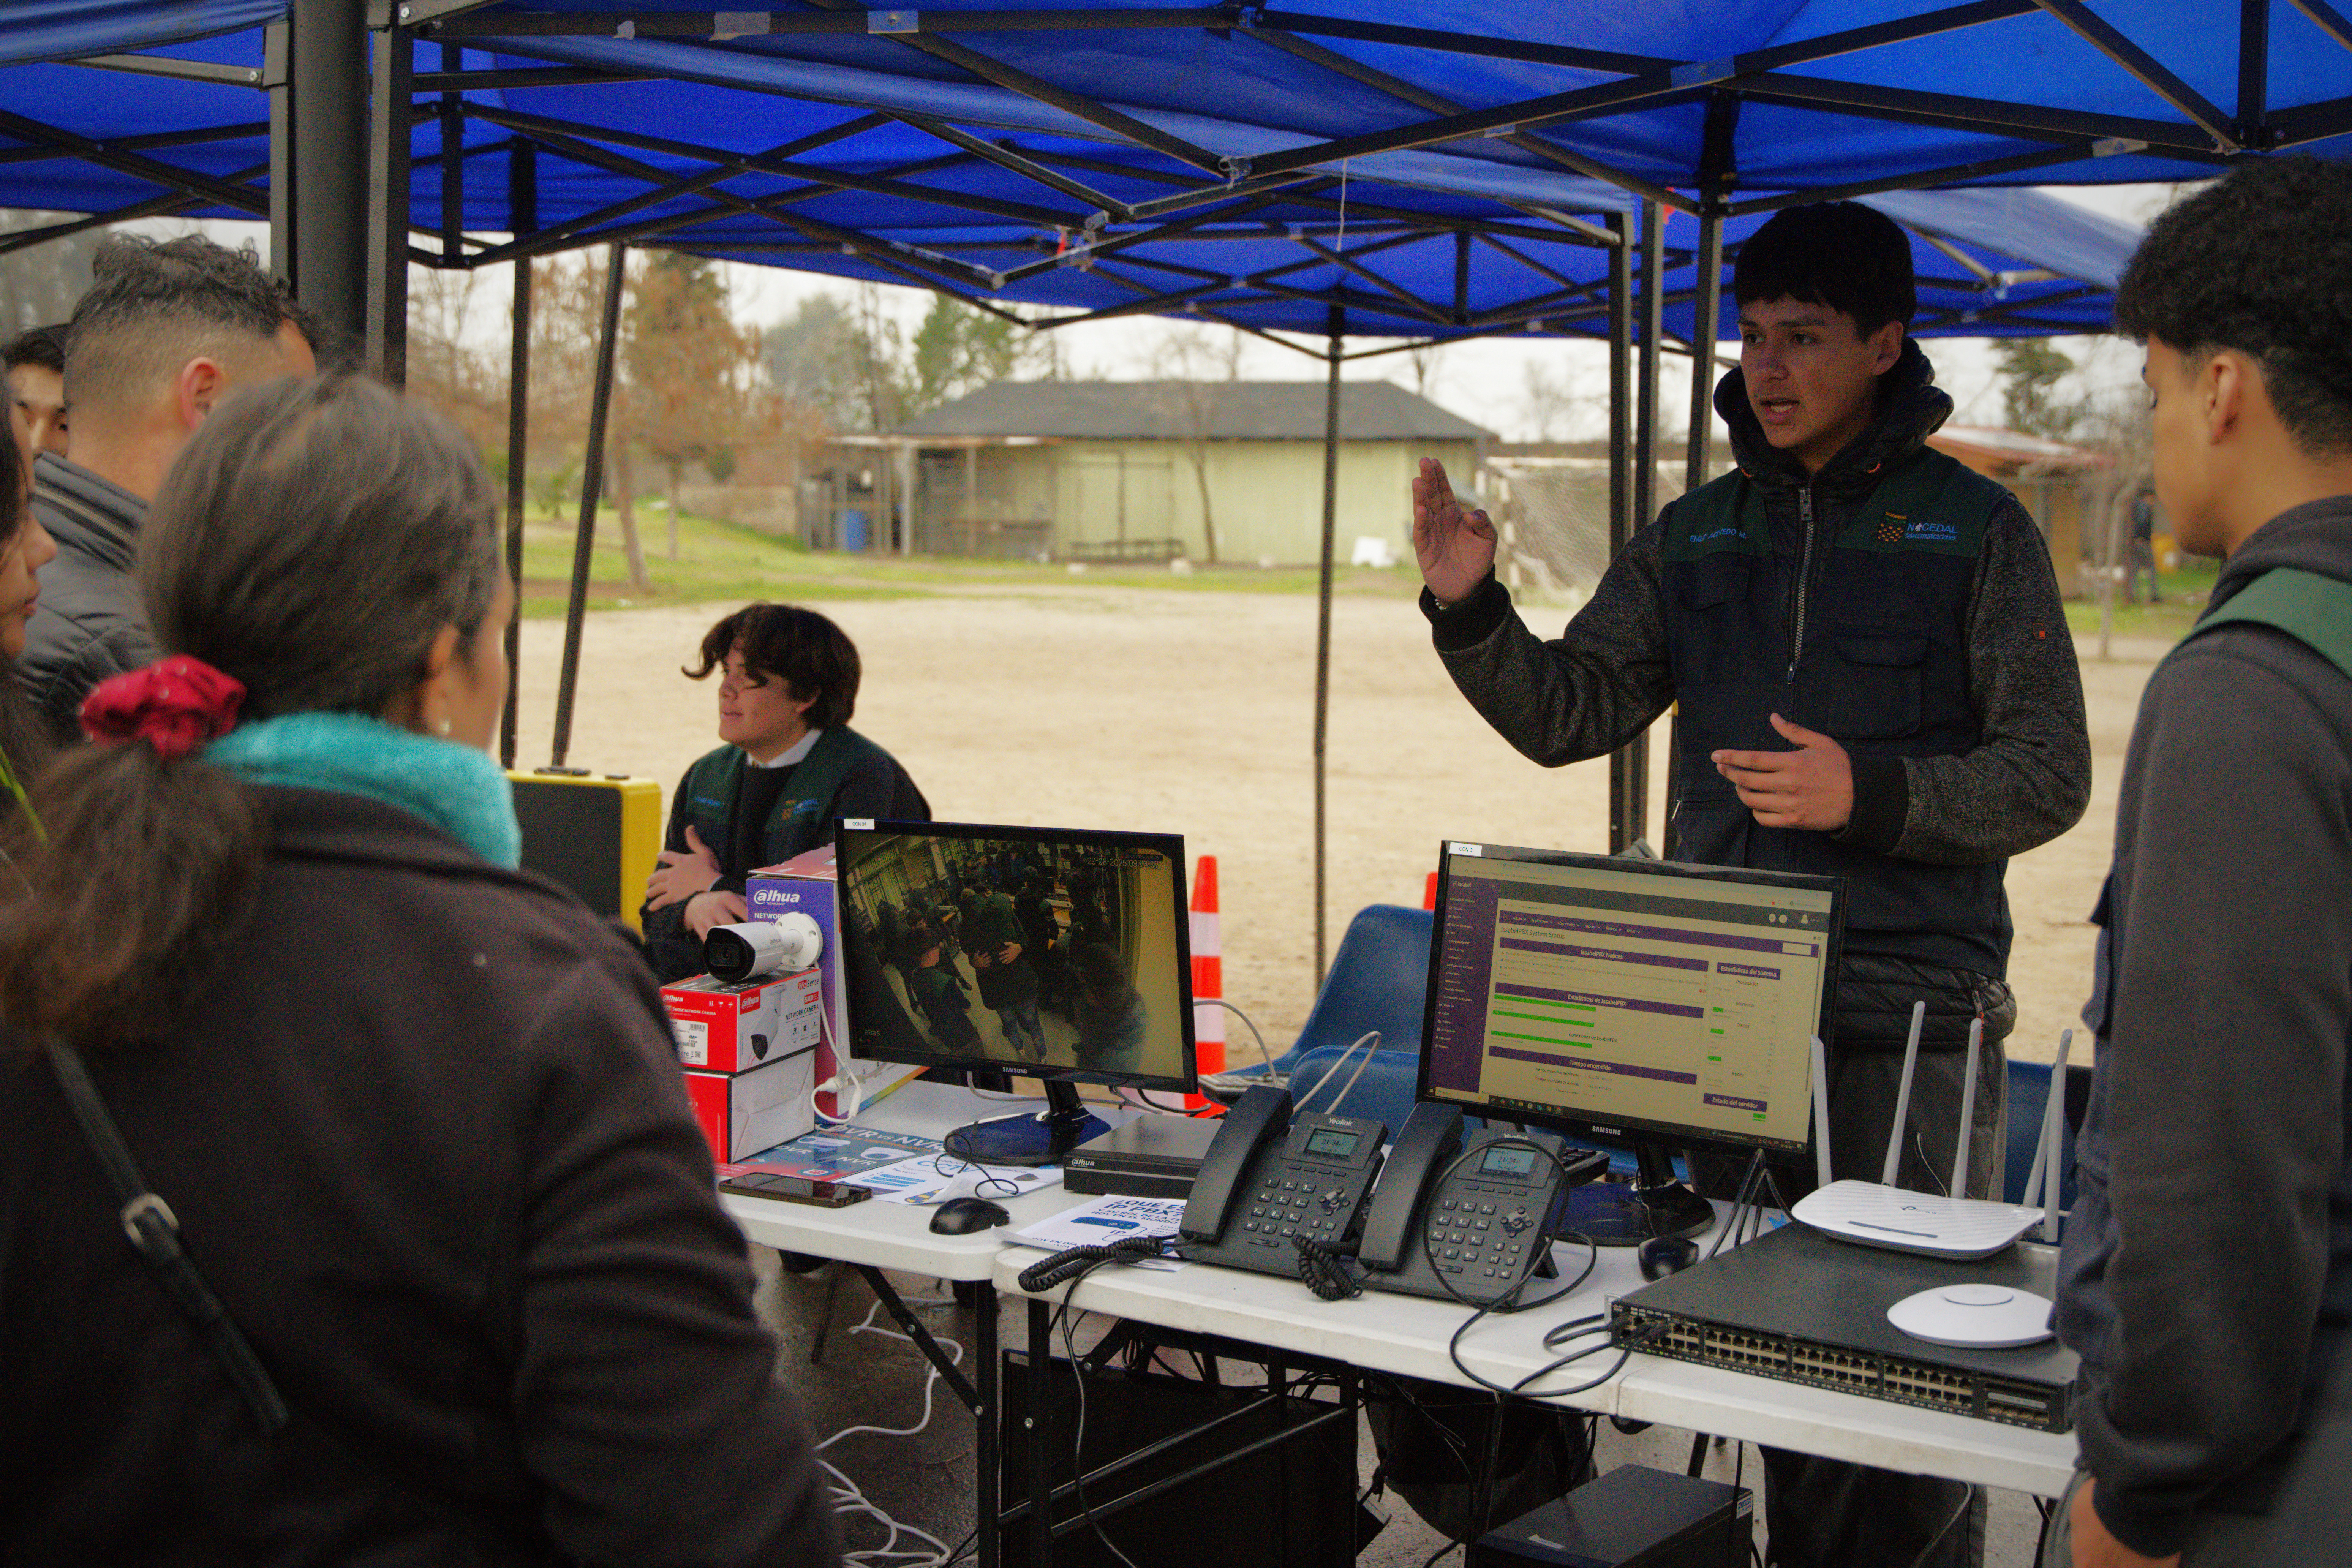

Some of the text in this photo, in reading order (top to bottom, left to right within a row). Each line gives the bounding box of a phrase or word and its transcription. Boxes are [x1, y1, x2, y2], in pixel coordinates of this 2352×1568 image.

[1907, 523, 1958, 534] NCEDAL
[1087, 857, 1127, 866] 29-08-2025
[1501, 927, 1528, 936] IssabelPBX
[1580, 949, 1605, 958] IssabelPBX
[1721, 966, 1748, 974] Estadísticas
[1568, 994, 1593, 1002] Estadísticas
[1601, 997, 1626, 1007] IssabelPBX
[786, 1004, 819, 1020] NETWORK CAMERA
[1596, 1035, 1618, 1043] IssabelPBX
[1002, 1066, 1028, 1075] SAMSUNG
[1587, 1062, 1611, 1071] encendido
[1329, 1117, 1353, 1127] Yealink
[1592, 1125, 1621, 1136] SAMSUNG
[892, 1136, 944, 1150] NVR
[774, 1146, 812, 1154] DVR
[837, 1156, 877, 1166] NVR
[1114, 1200, 1164, 1208] ¿QUÉ
